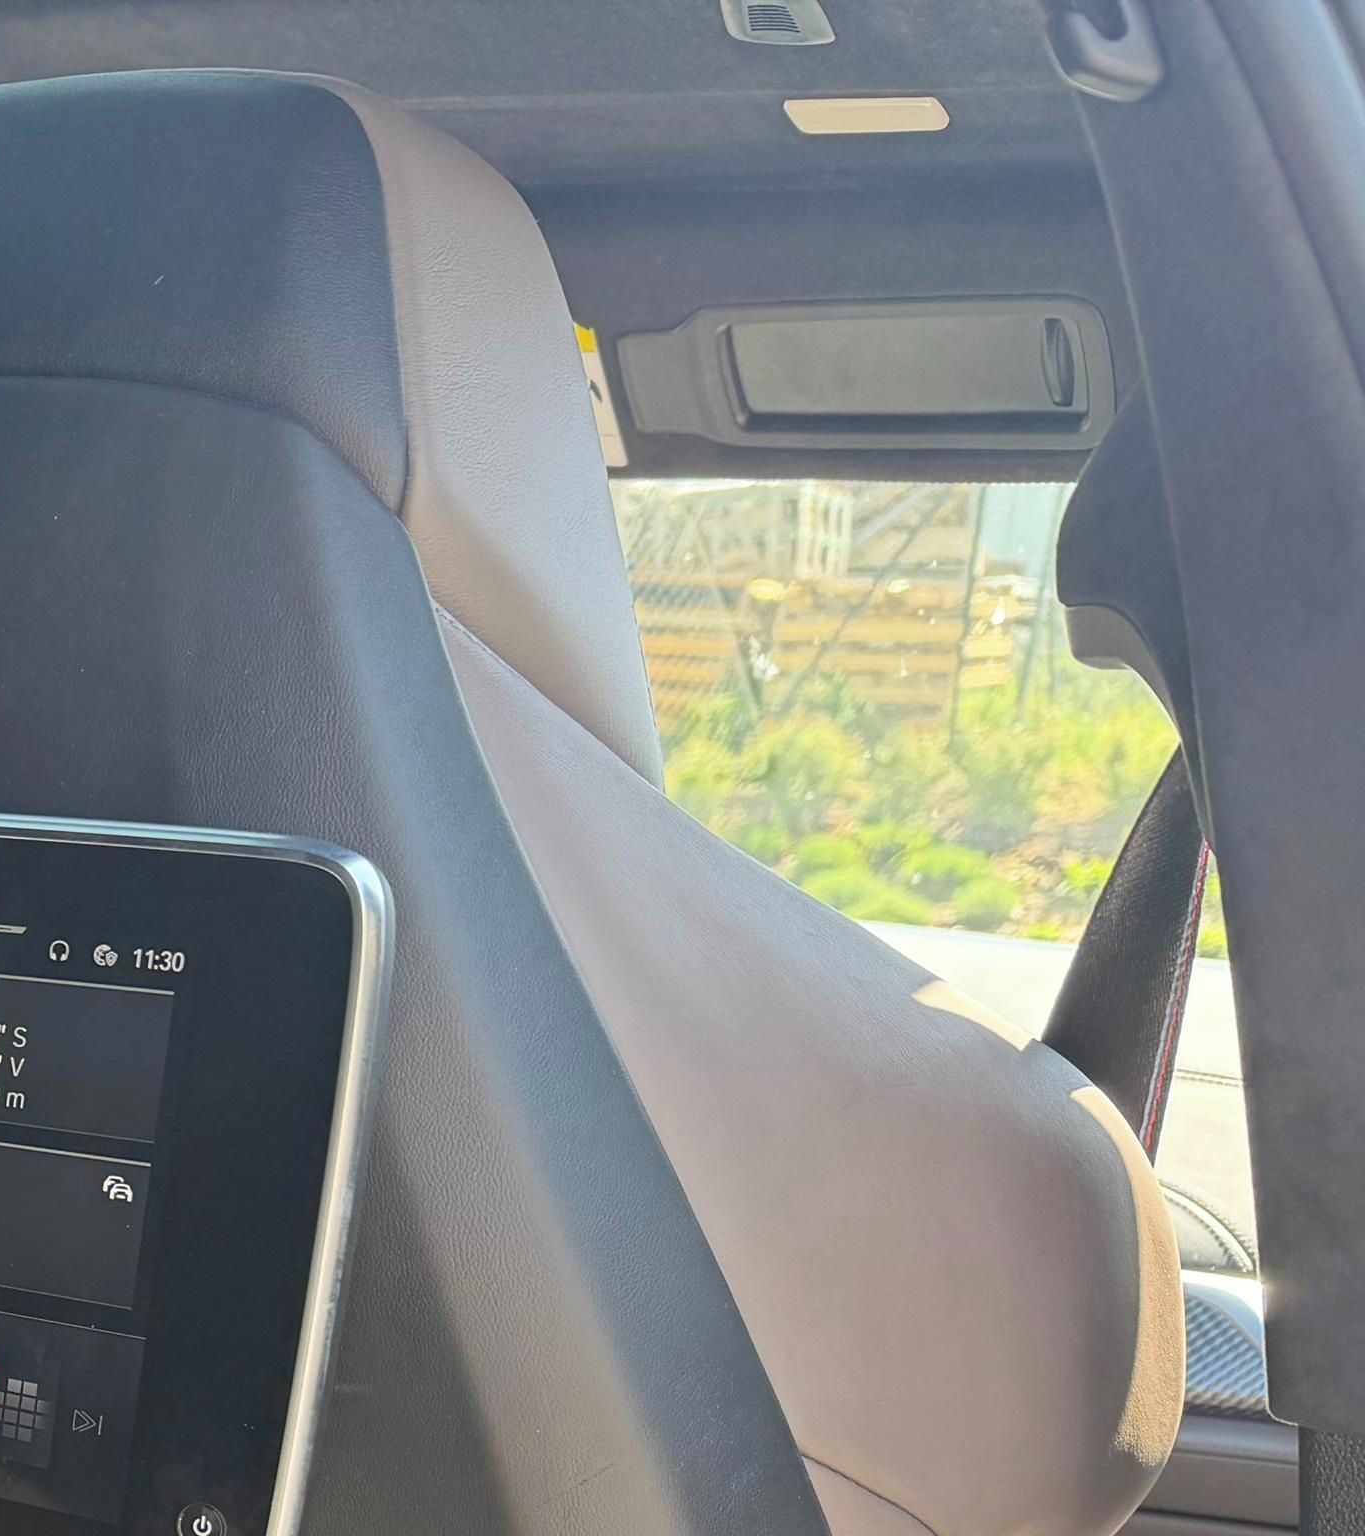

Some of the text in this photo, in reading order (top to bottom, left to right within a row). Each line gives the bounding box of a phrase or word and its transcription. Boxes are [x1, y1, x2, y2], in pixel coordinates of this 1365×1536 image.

[132, 949, 186, 973] 11:30
[12, 1026, 28, 1048] S
[10, 1056, 25, 1077] V
[5, 1091, 25, 1109] m
